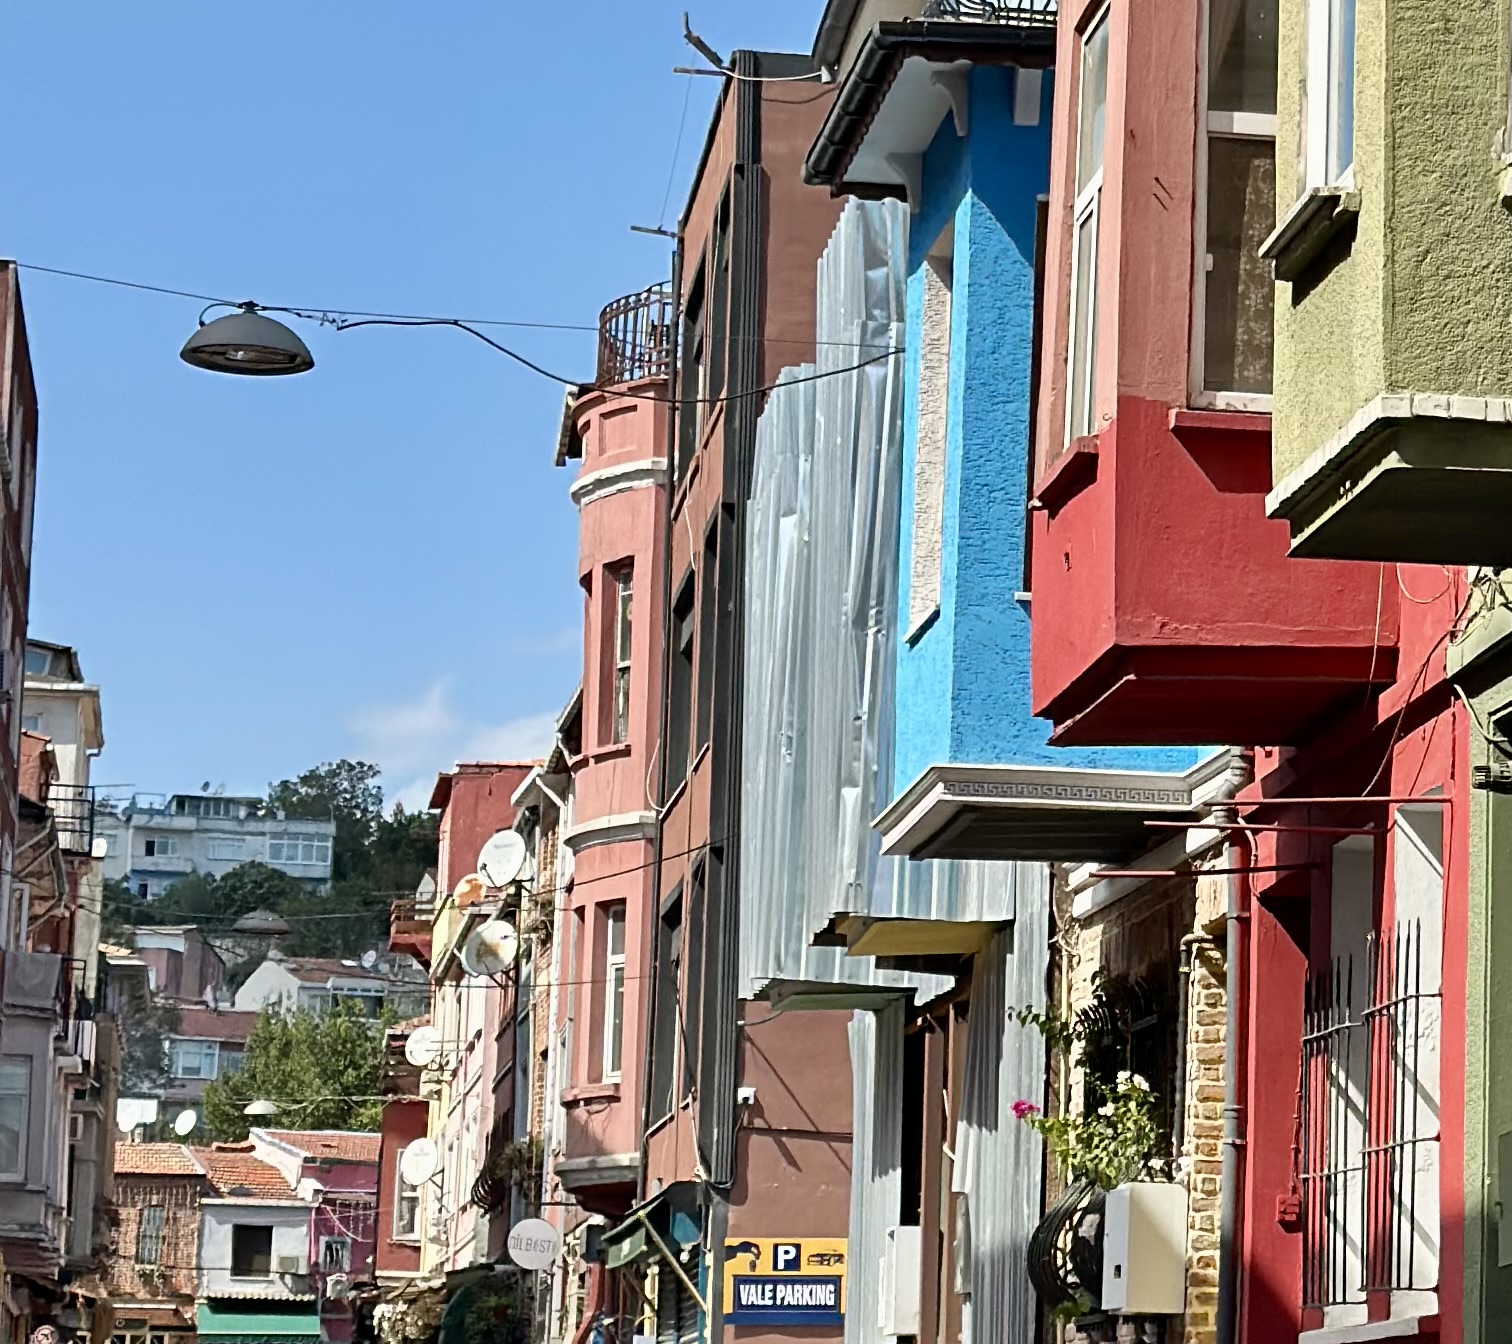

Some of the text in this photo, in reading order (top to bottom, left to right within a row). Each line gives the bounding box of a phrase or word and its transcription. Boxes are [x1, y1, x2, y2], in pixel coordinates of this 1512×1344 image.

[777, 1245, 797, 1270] P
[739, 1284, 835, 1306] VALE PARKING
